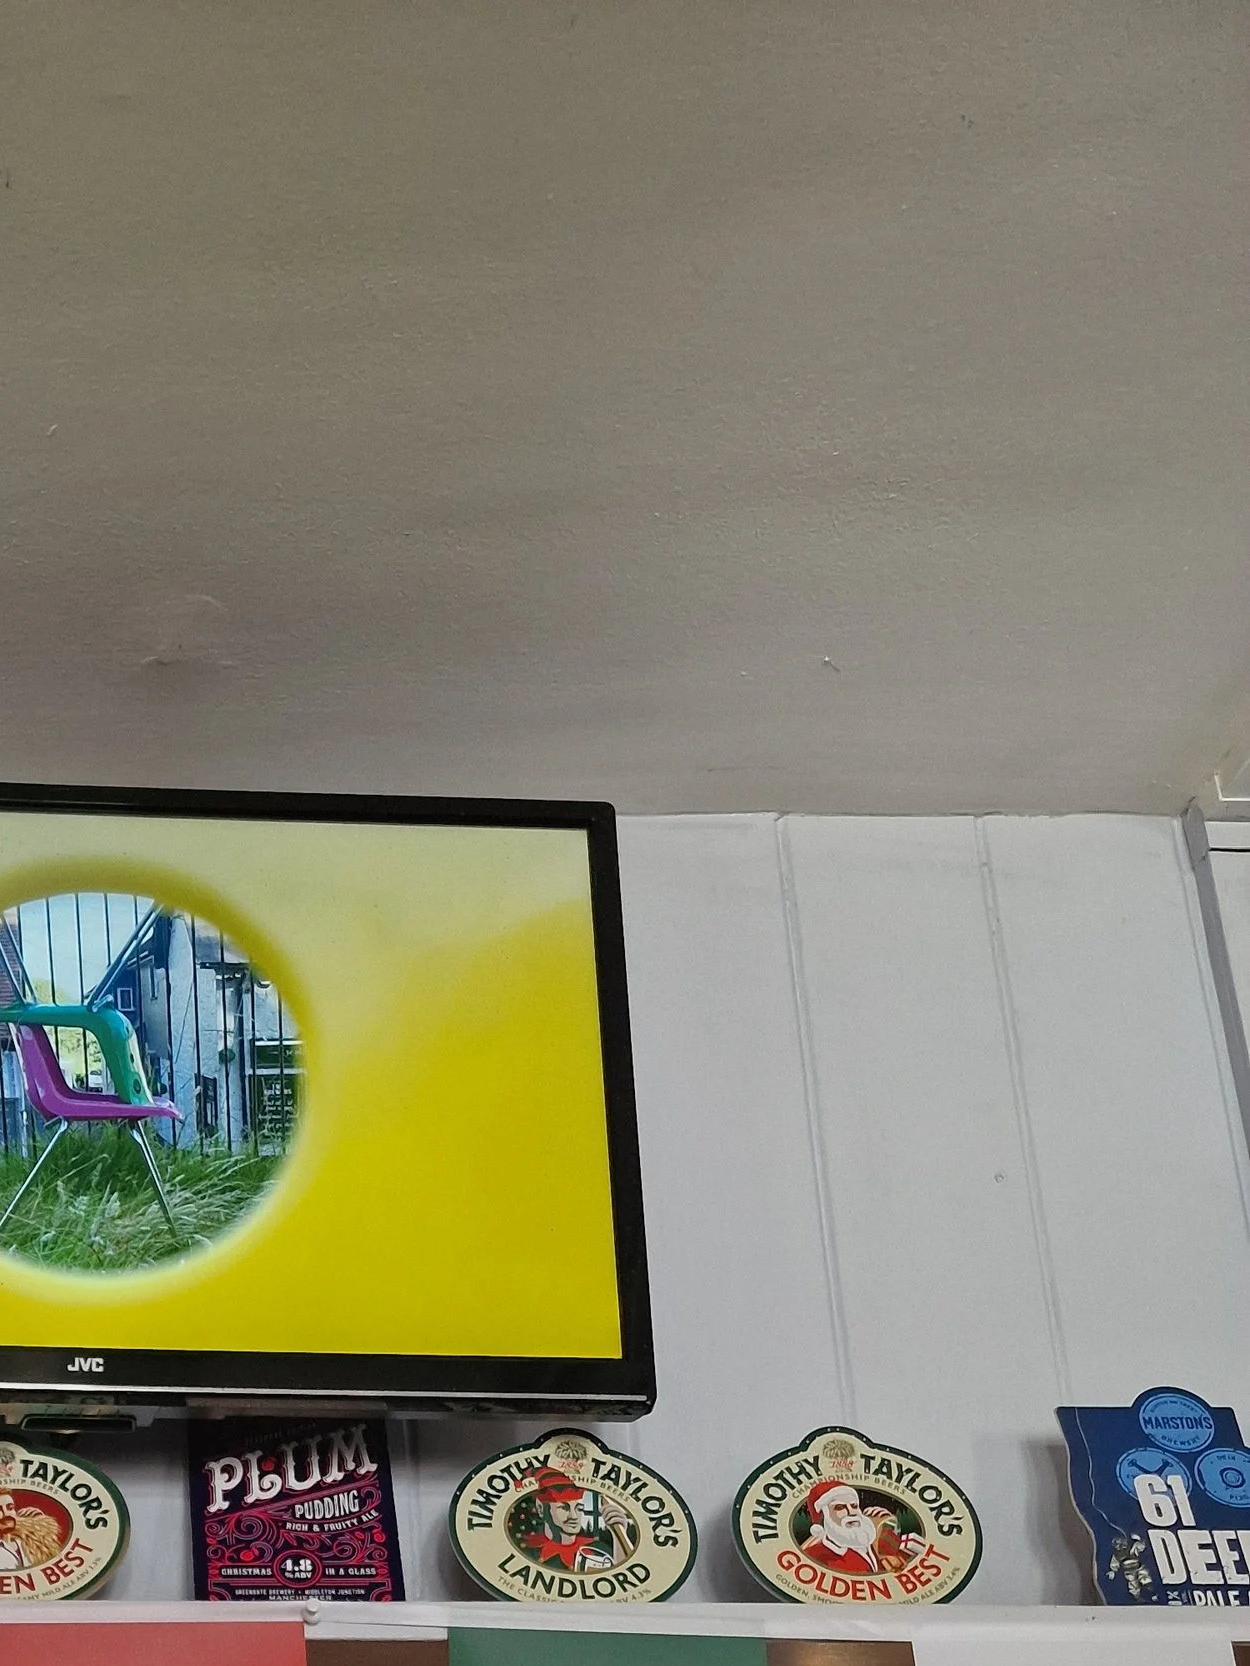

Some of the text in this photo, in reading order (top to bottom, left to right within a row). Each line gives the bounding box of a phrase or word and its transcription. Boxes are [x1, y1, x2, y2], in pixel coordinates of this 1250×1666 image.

[68, 1357, 104, 1373] JVC
[1142, 1414, 1213, 1430] MARSTON'S
[204, 1422, 379, 1514] PLUM
[19, 1459, 108, 1531] TAYLOR'S
[30, 1480, 59, 1495] BEERS
[600, 1481, 632, 1501] BEERS
[791, 1473, 907, 1499] CHAMPIONSHIP BEERS
[294, 1489, 360, 1520] PUDDING
[467, 1453, 679, 1549] TIMOTHY TAYLOR'S
[751, 1453, 964, 1545] TIMOTHY TAYLOR'S
[1134, 1473, 1196, 1528] 61
[285, 1509, 379, 1532] RICH & FRUITY ALE
[40, 1537, 94, 1586] BEST
[221, 1568, 272, 1576] CHRISTMAS
[283, 1558, 313, 1572] 4.8
[348, 1567, 376, 1576] GLASS
[776, 1543, 950, 1602] GOLDEN BEST
[63, 1579, 75, 1590] ALE
[76, 1569, 90, 1583] ABV
[497, 1553, 652, 1600] LANDLORD
[498, 1577, 516, 1592] THE
[920, 1587, 934, 1600] ALE
[934, 1577, 949, 1592] ABV
[1193, 1590, 1241, 1606] PALE
